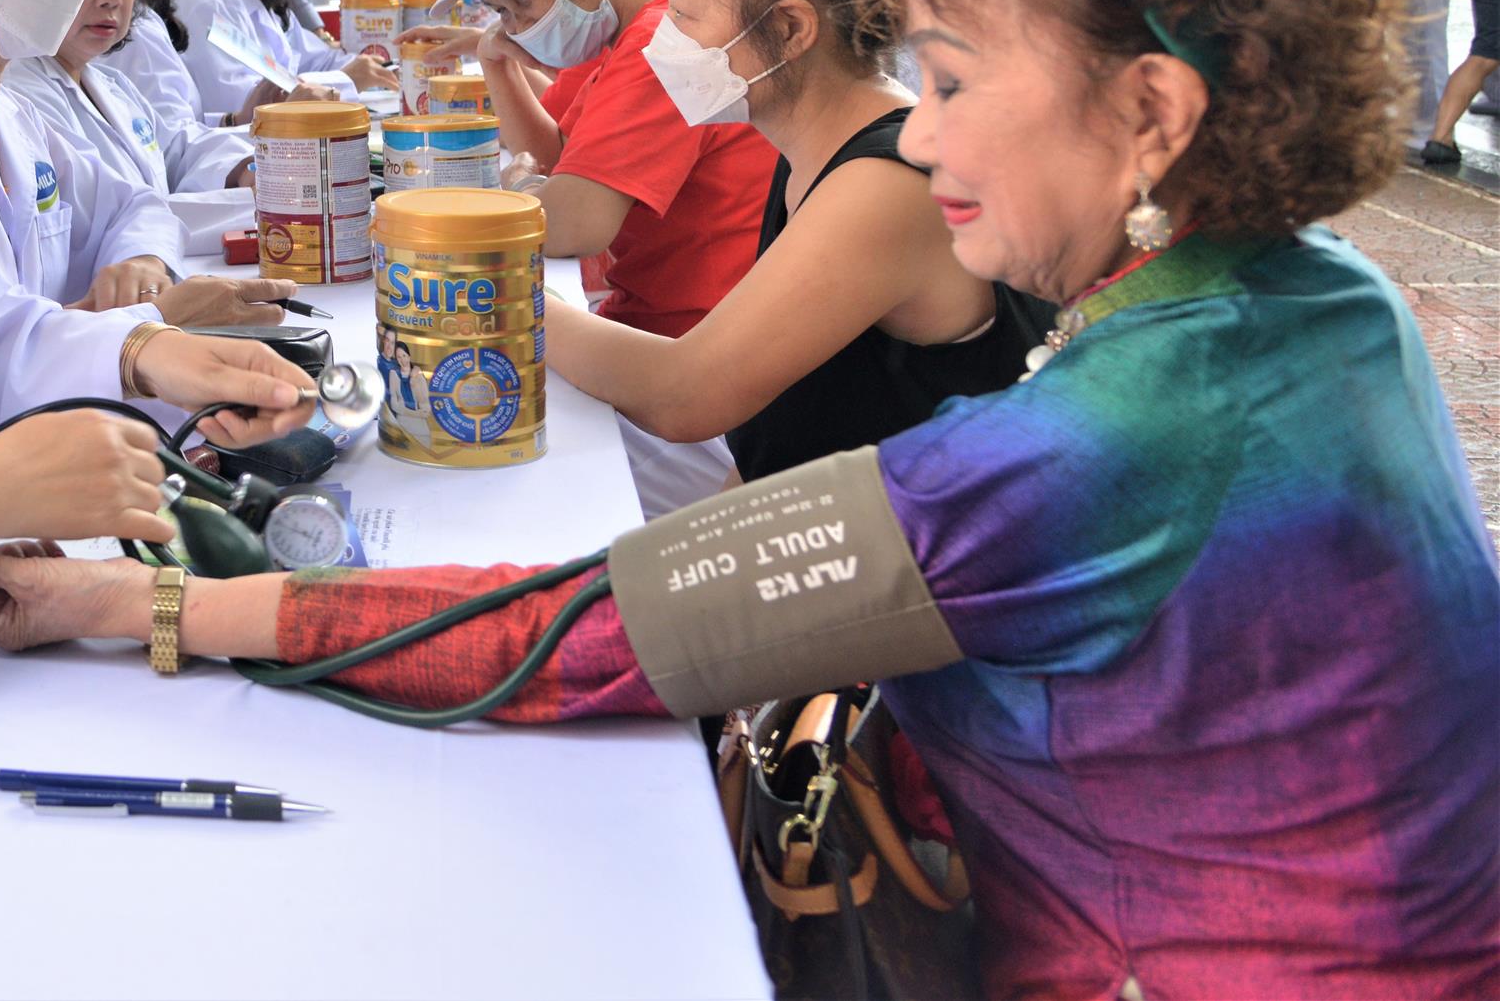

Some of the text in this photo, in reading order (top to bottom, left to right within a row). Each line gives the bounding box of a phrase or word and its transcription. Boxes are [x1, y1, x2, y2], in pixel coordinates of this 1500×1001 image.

[354, 15, 394, 32] Sure
[387, 262, 496, 314] Sure
[387, 309, 496, 336] Prevent Gold
[667, 520, 846, 592] ADULT CUFF
